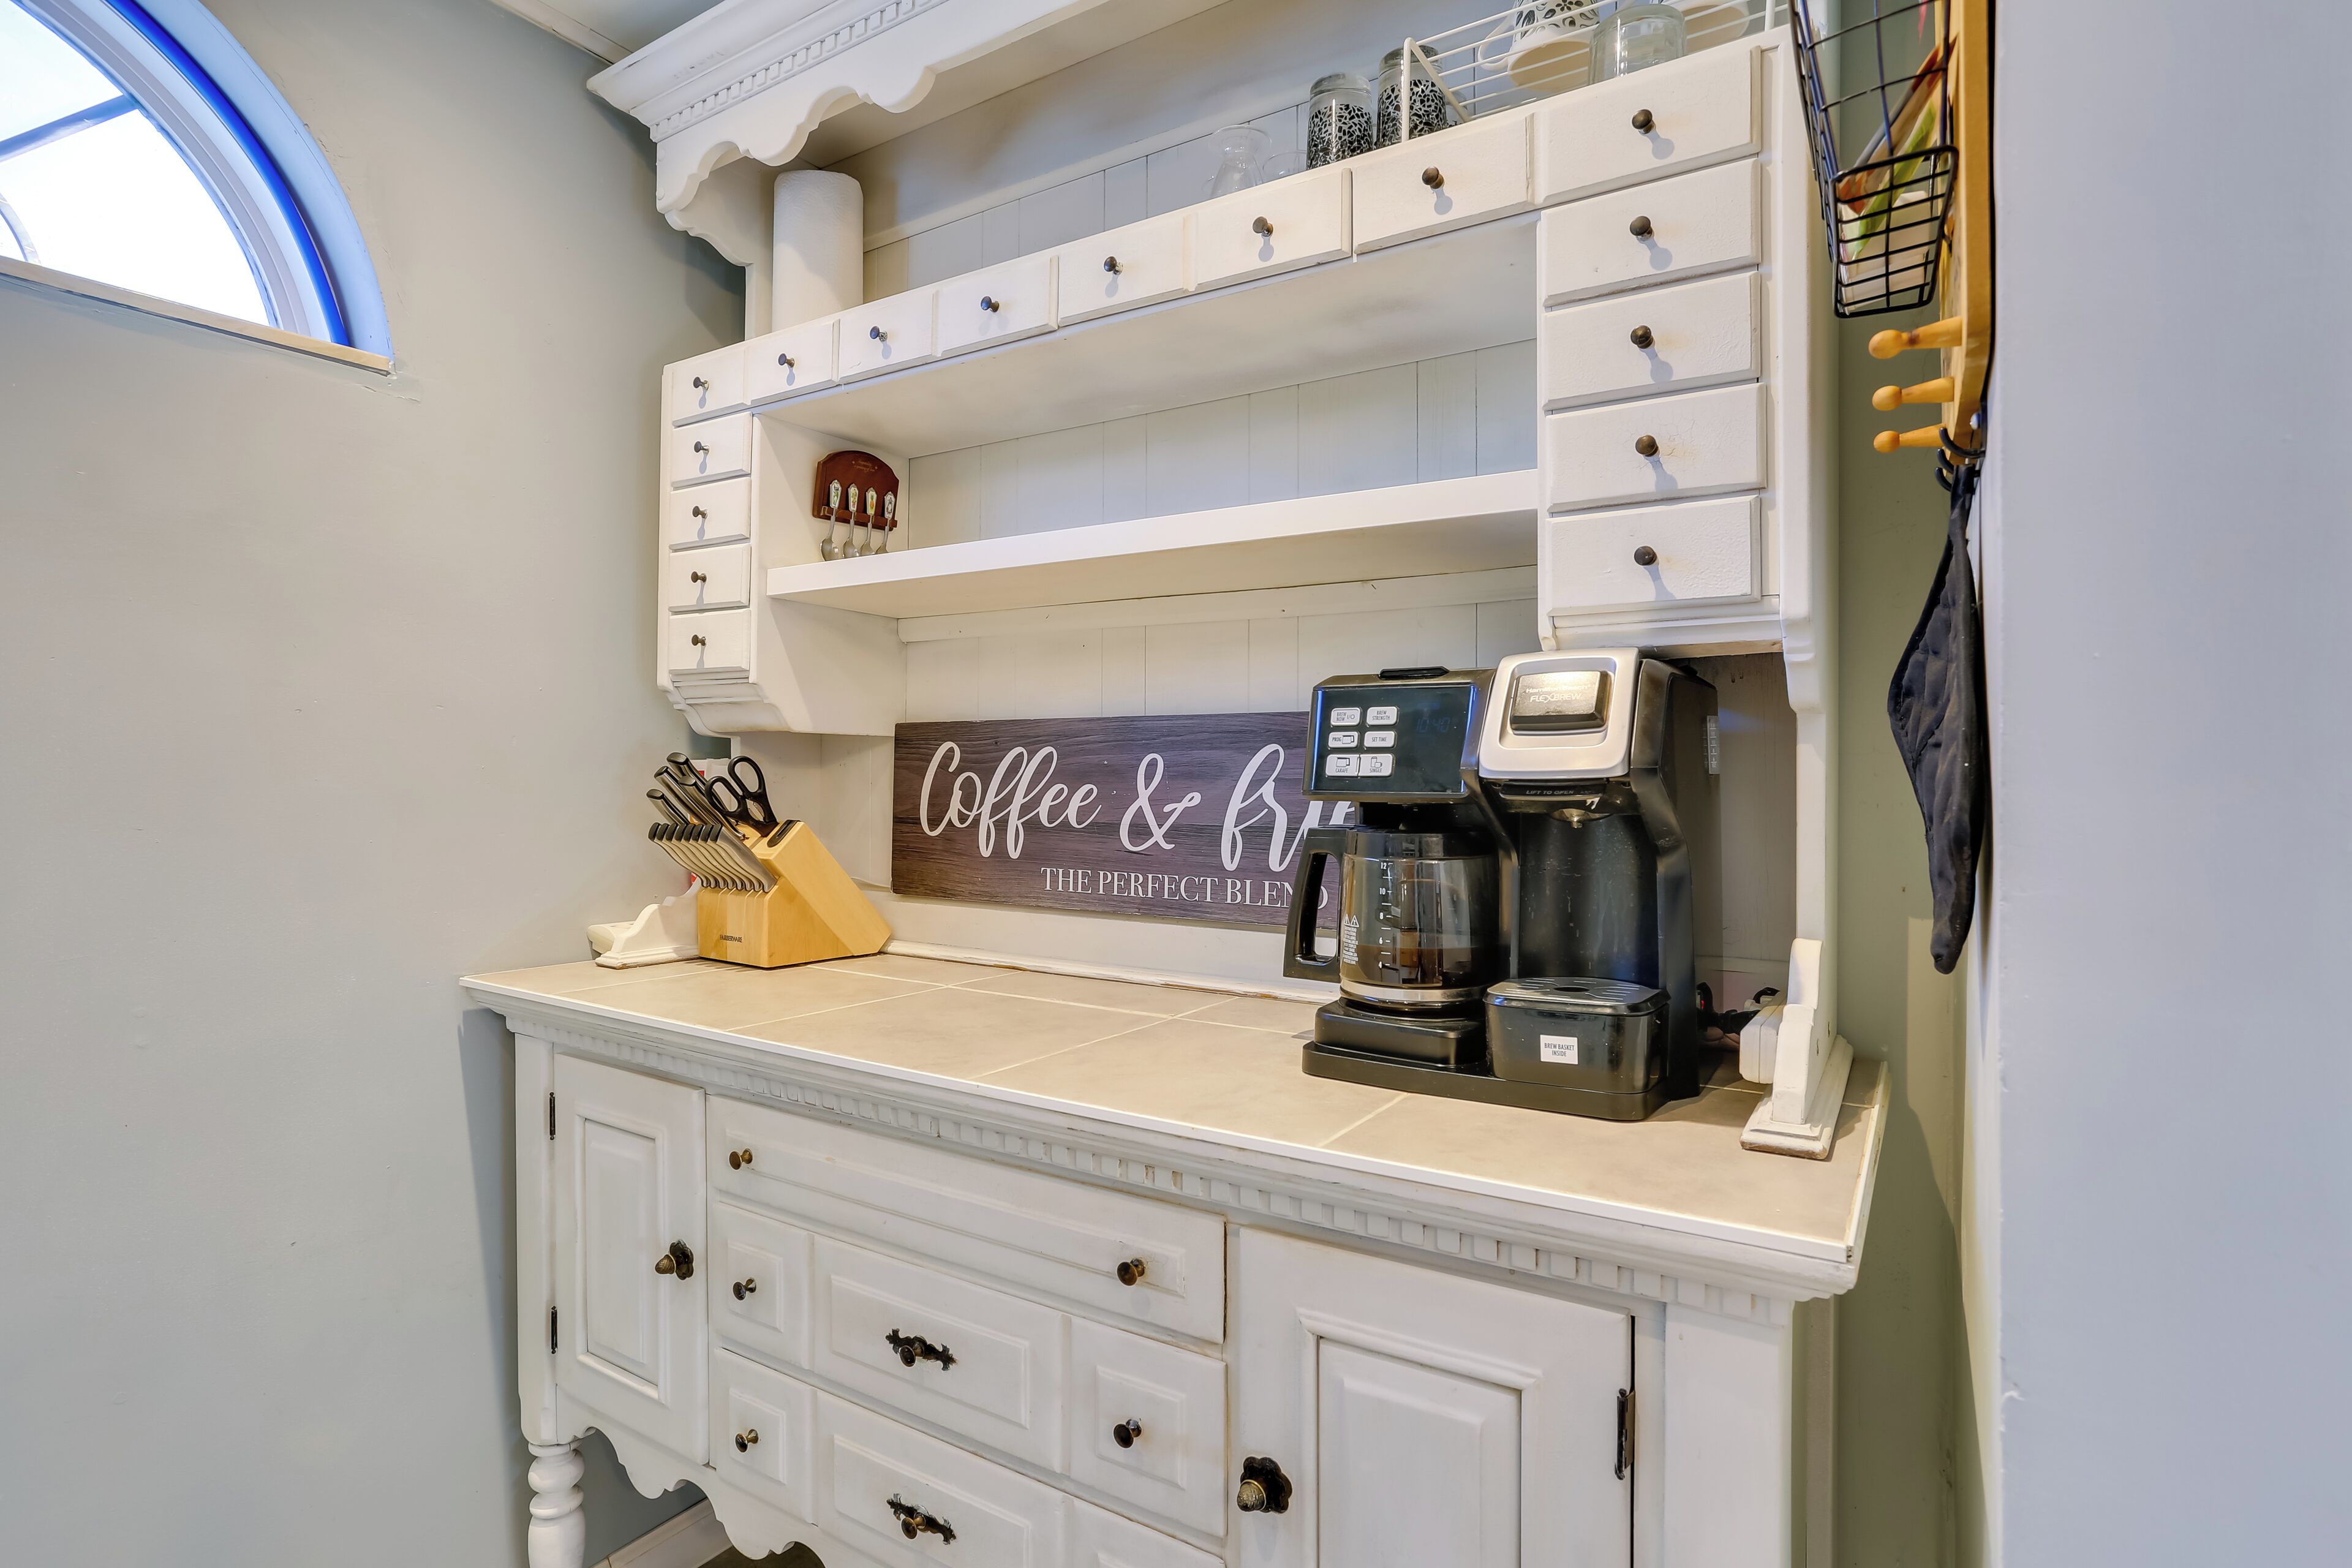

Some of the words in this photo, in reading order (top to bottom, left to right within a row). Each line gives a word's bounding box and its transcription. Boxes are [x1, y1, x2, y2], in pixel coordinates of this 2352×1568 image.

[1530, 693, 1582, 703] FLEXBREW
[920, 741, 1102, 859] Coffee
[1119, 753, 1201, 851] &
[1040, 867, 1092, 894] THE
[1097, 870, 1218, 902] PERFECT
